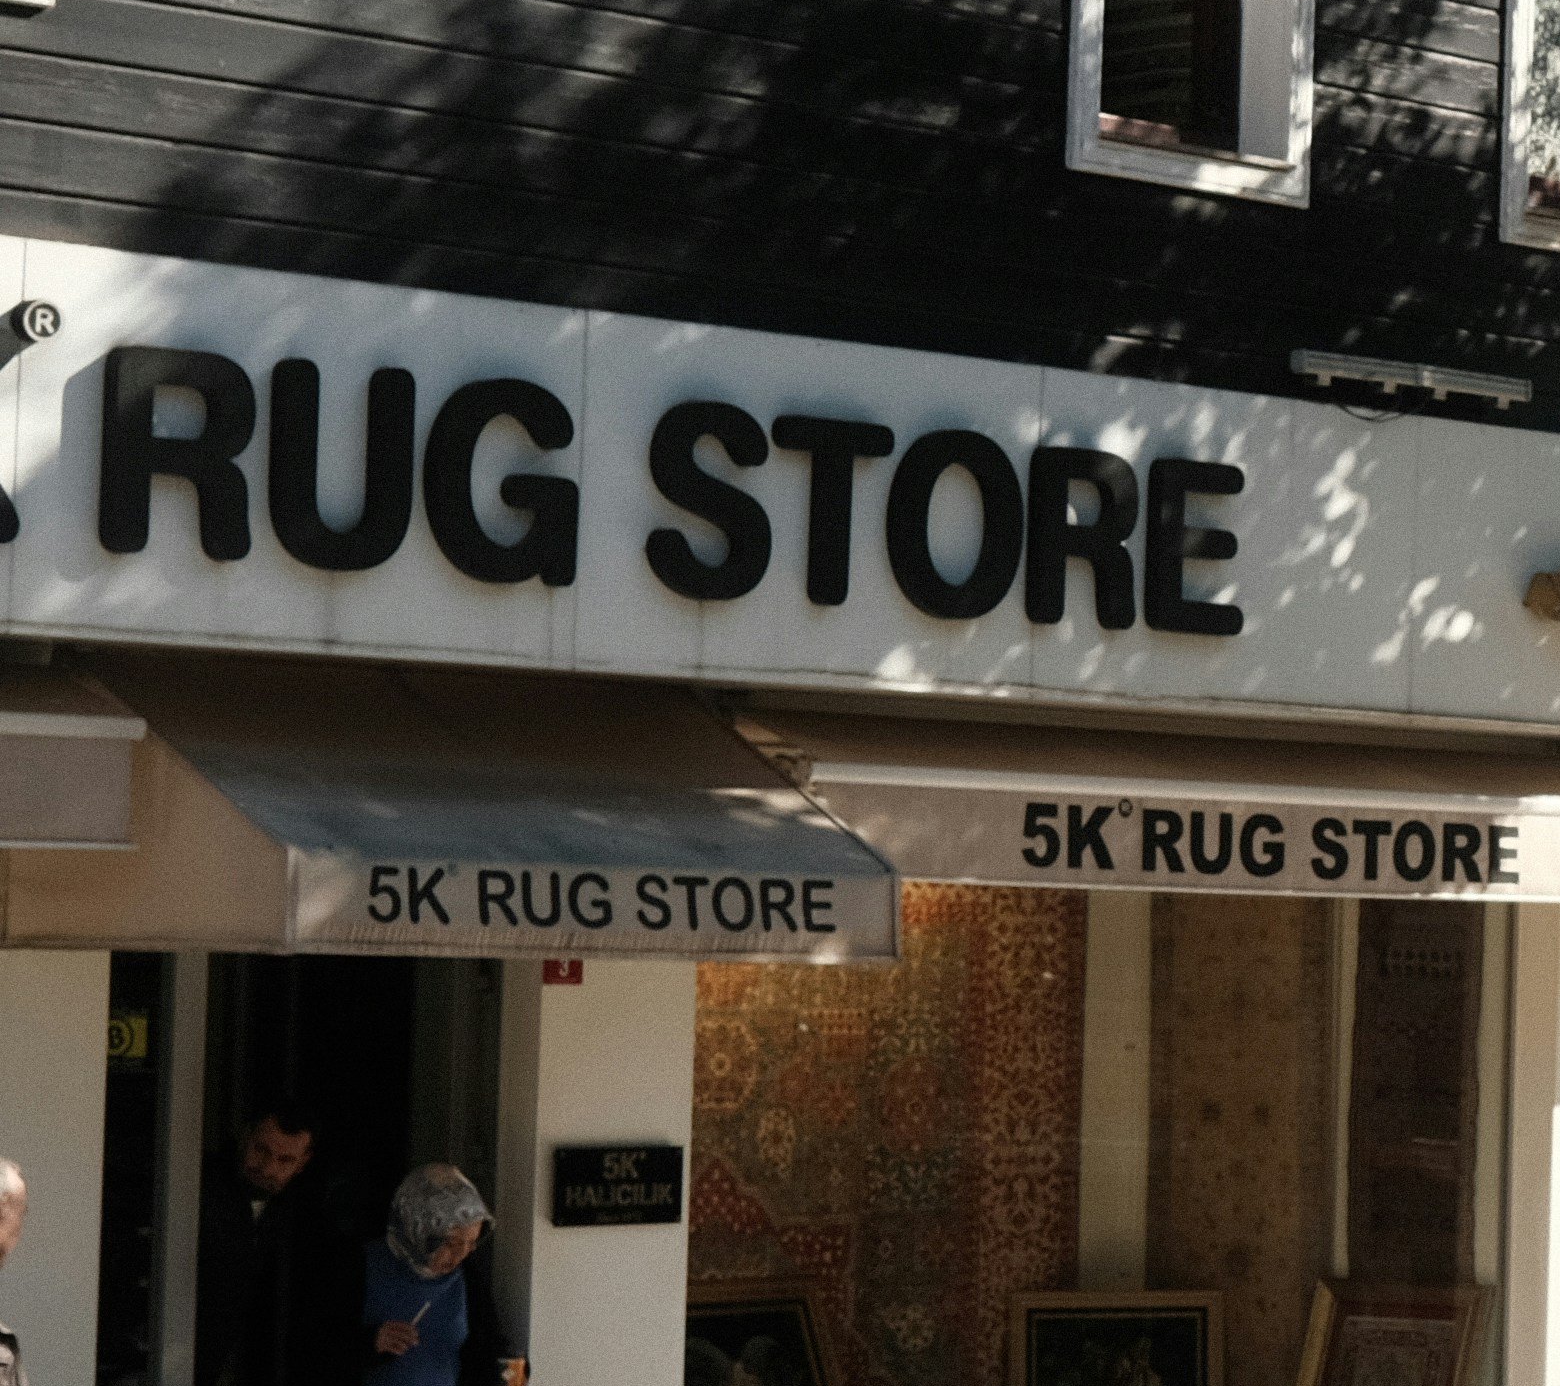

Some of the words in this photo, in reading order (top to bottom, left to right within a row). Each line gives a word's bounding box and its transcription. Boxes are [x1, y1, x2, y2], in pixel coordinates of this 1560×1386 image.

[98, 345, 580, 587] RUG
[645, 400, 1245, 636] STORE
[1141, 808, 1286, 877] RUG
[1310, 816, 1520, 884] STORE
[477, 869, 613, 928] RUG
[635, 873, 837, 933] STORE
